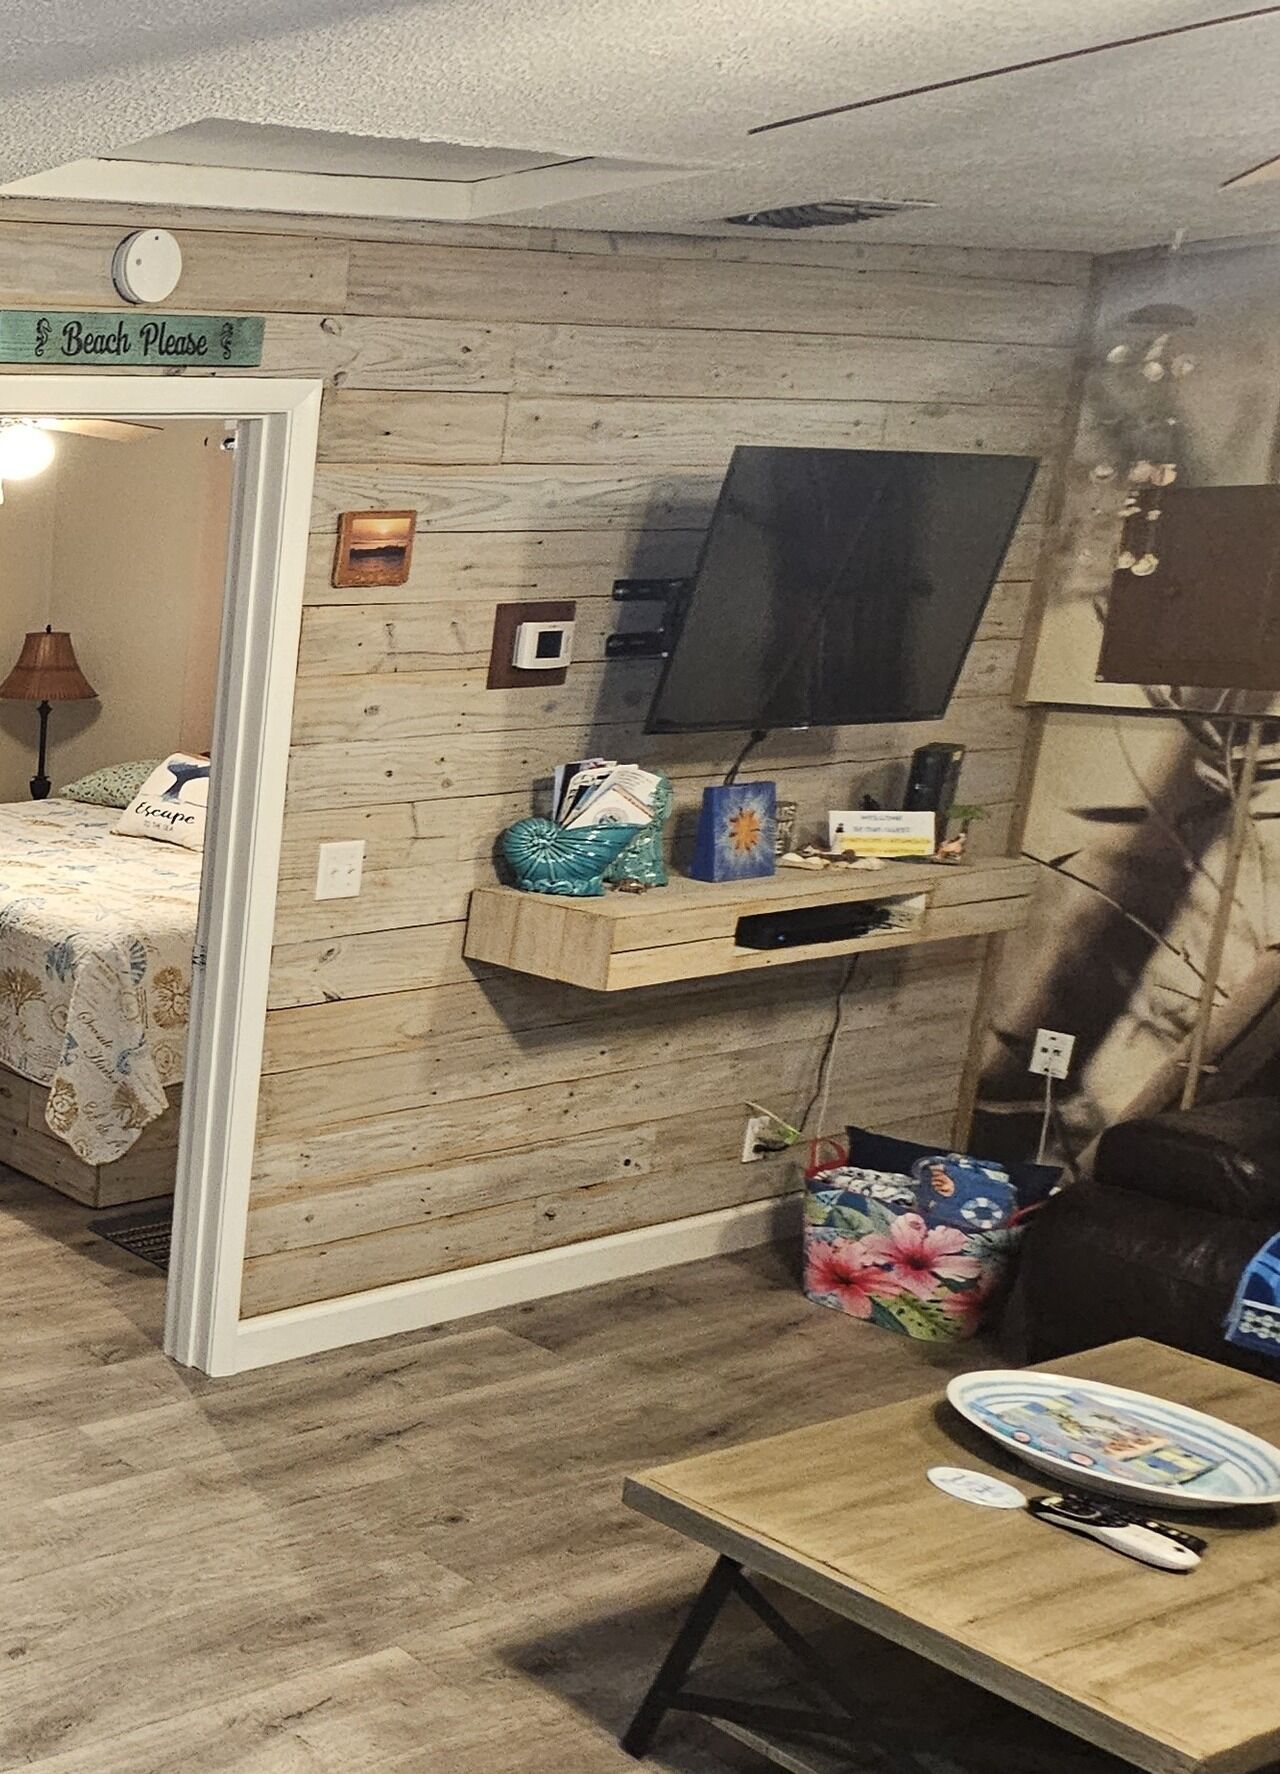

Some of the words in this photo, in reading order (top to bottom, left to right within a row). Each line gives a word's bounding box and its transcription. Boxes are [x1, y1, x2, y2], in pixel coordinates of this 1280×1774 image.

[61, 320, 131, 356] Beach
[140, 321, 208, 356] Please
[135, 802, 195, 825] Escape
